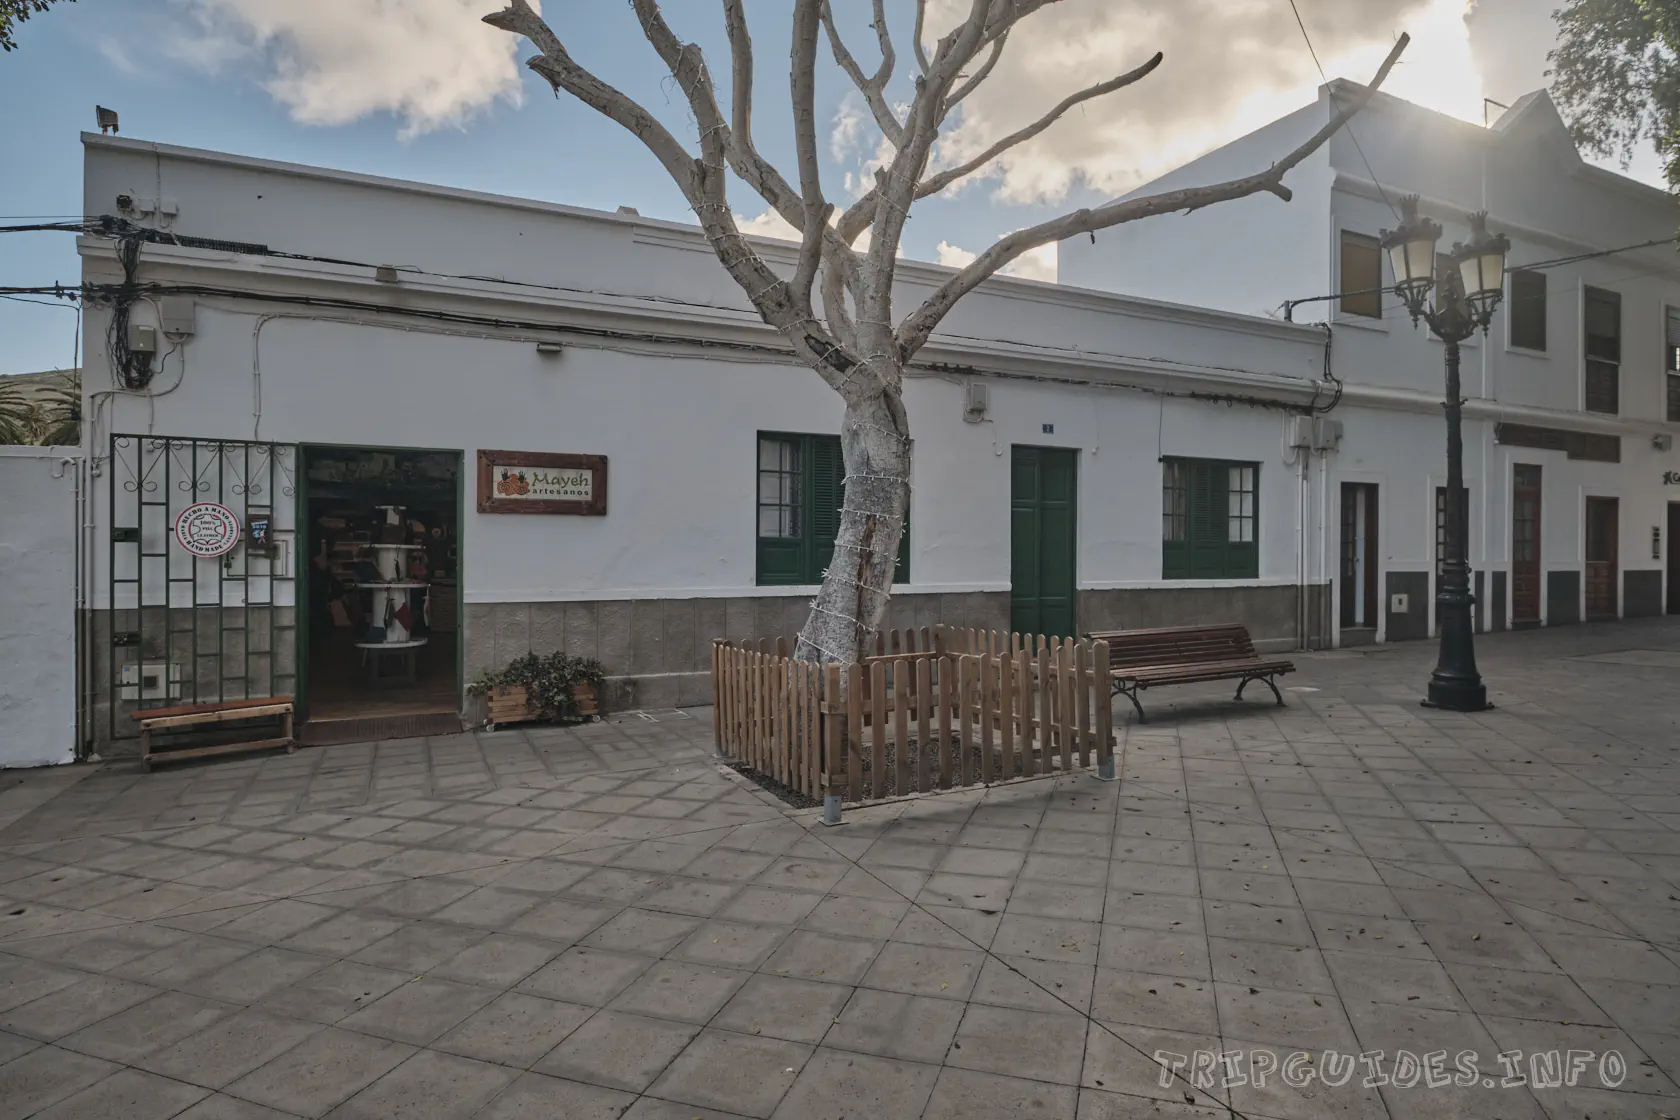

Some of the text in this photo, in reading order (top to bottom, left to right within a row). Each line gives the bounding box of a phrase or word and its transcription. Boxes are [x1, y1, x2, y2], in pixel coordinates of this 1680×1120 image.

[532, 472, 589, 488] Mayeh
[533, 488, 589, 496] artesanos
[182, 507, 202, 524] HECHO
[211, 507, 230, 520] MANO
